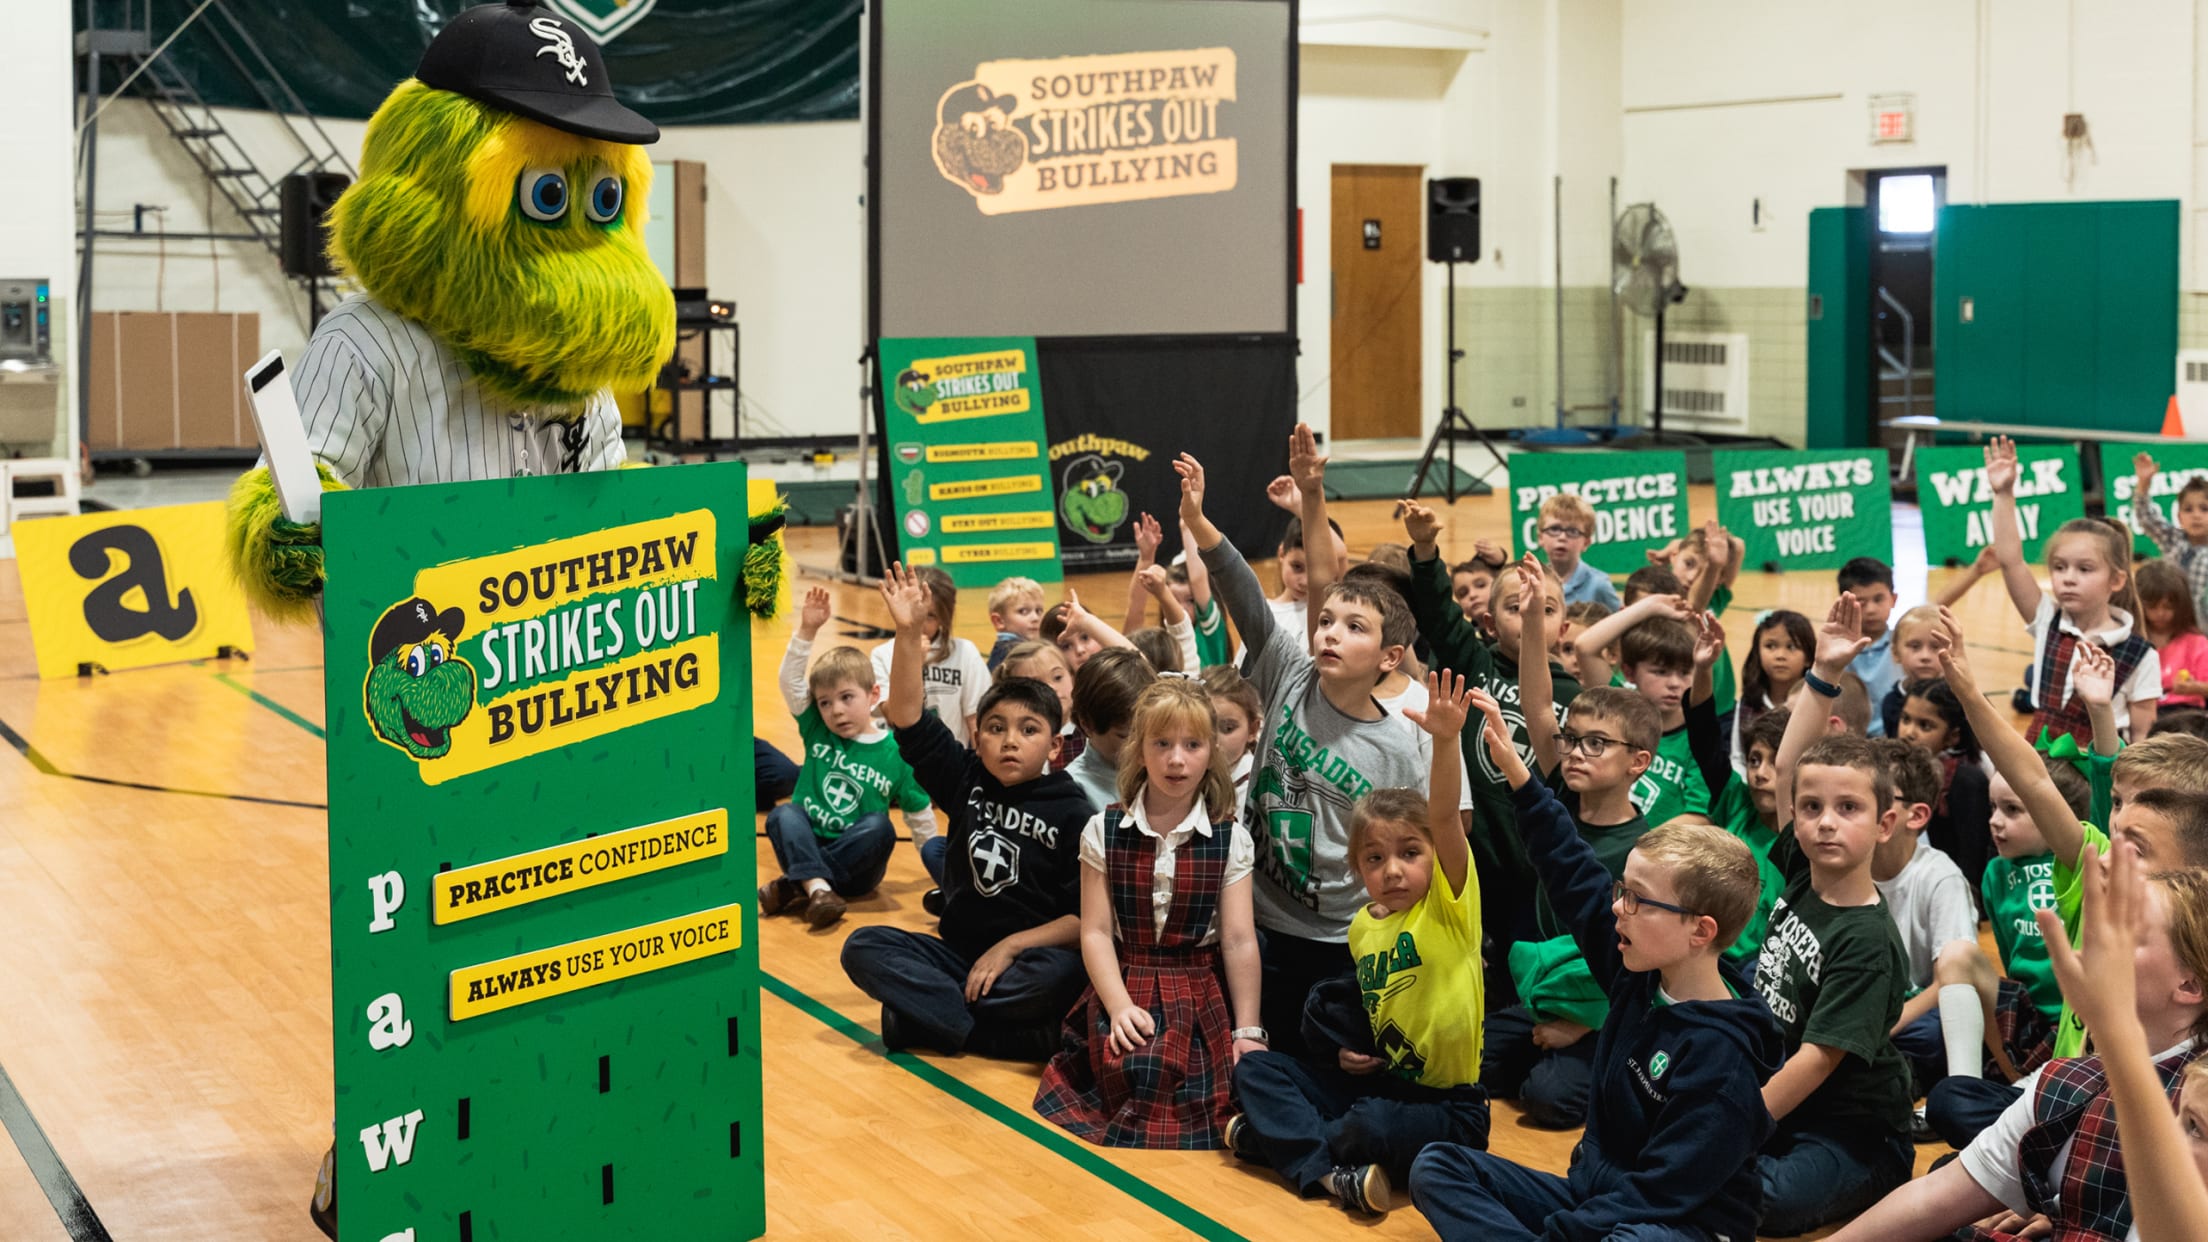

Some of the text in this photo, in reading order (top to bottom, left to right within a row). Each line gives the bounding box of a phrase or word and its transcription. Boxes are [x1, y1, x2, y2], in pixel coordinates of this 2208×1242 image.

[1031, 64, 1220, 101] SOUTHPAW
[1031, 98, 1222, 155] STRIKES OUT
[1037, 151, 1218, 192] BULLYING
[935, 356, 1017, 376] SOUTHPAW
[936, 371, 1020, 399] STRIKES OUT
[941, 393, 1021, 414] BULLYING
[1048, 433, 1151, 461] outhpaw
[1730, 458, 1874, 499] ALWAYS
[2113, 467, 2208, 500] SAN
[1522, 503, 1677, 550] CDENCE
[1752, 492, 1855, 528] USE YOUR
[1776, 525, 1836, 557] VOICE
[68, 524, 198, 643] a
[479, 531, 699, 614] SOUTHPAW
[481, 580, 699, 689] STRIKES OUT
[922, 664, 962, 686] ADER
[488, 652, 699, 745] BULLYING
[967, 786, 1060, 850] CSADERS
[449, 823, 718, 908] PRACTICE CONFIDENCE
[367, 869, 405, 934] p
[467, 919, 729, 1003] ALWAYS USE YOUR VOICE
[366, 991, 413, 1051] a
